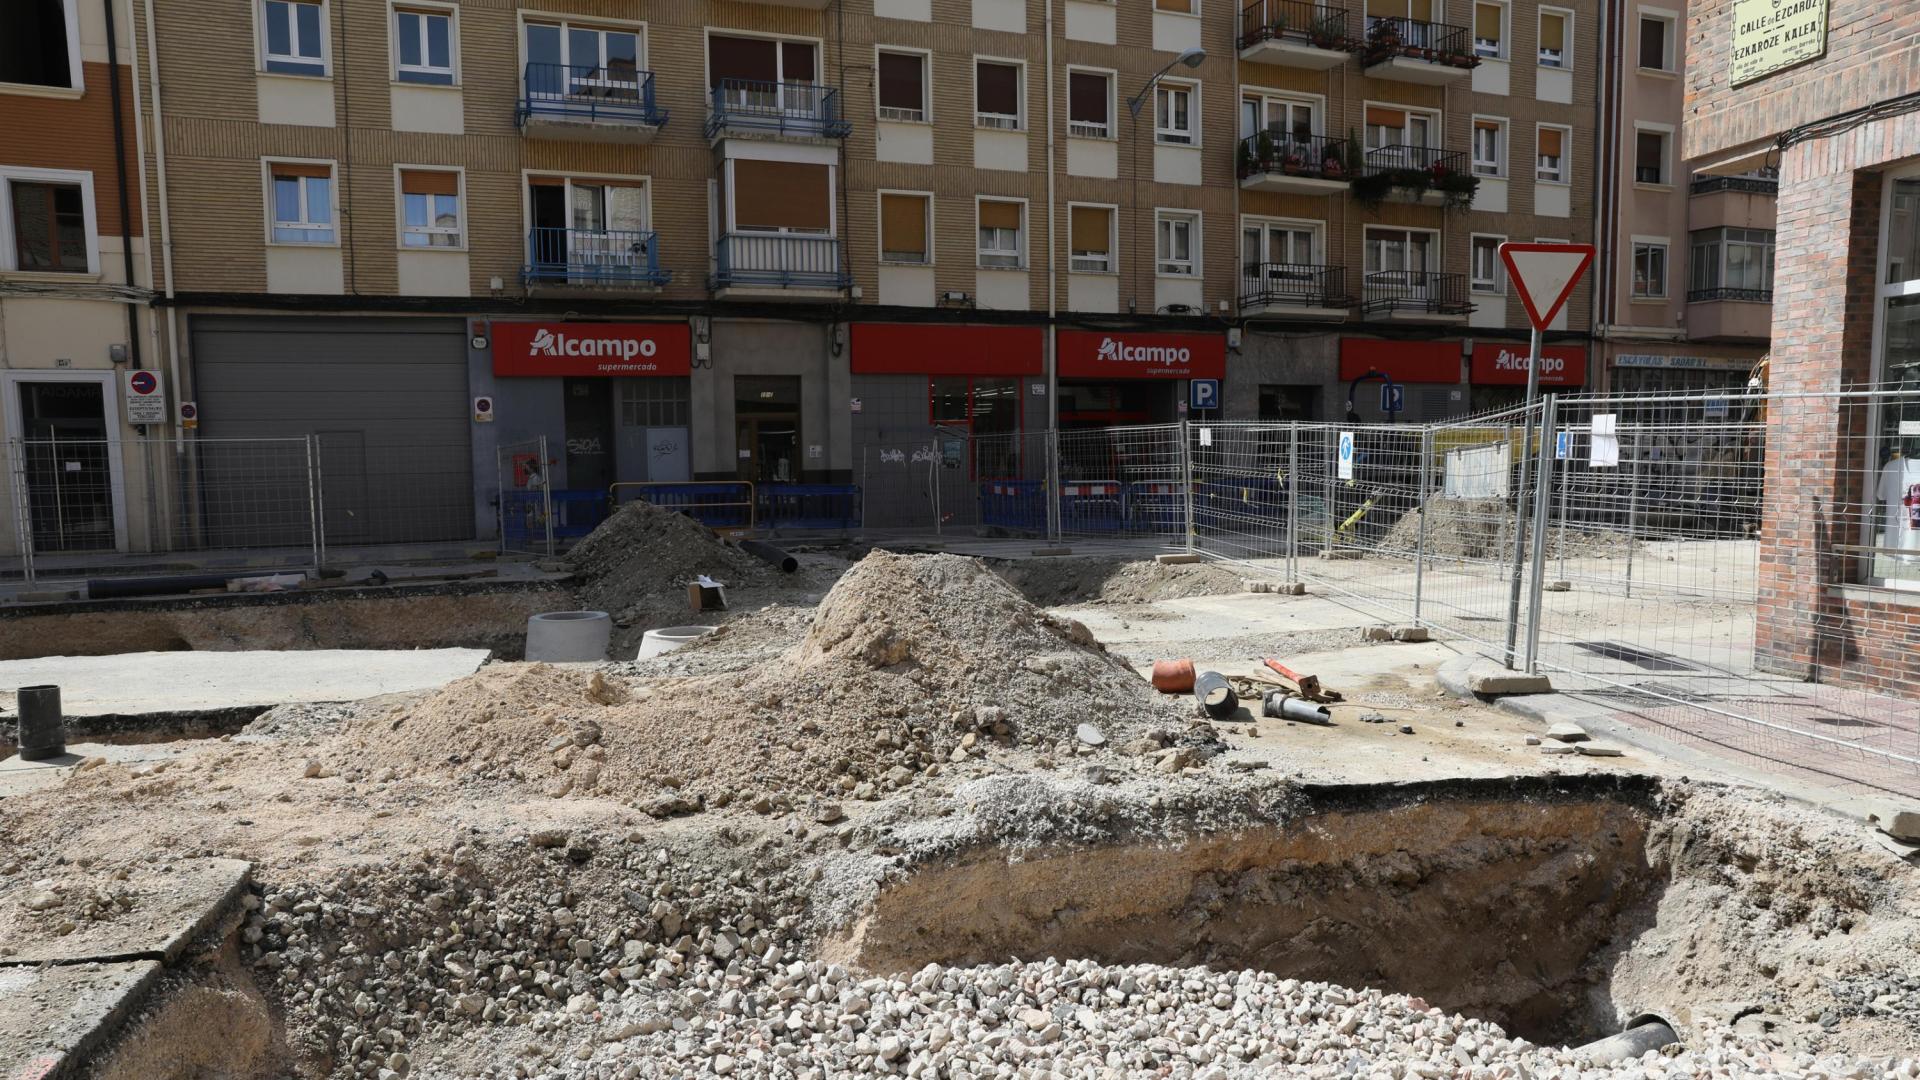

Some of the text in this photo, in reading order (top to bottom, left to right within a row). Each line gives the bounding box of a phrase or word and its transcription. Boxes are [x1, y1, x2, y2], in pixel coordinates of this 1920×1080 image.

[1740, 16, 1767, 35] CALLE
[1734, 21, 1816, 60] EZKAROZE KALEA
[529, 328, 657, 360] Alcampo
[1097, 337, 1190, 366] Alcampo
[597, 362, 657, 372] supermercado
[1197, 383, 1212, 405] P
